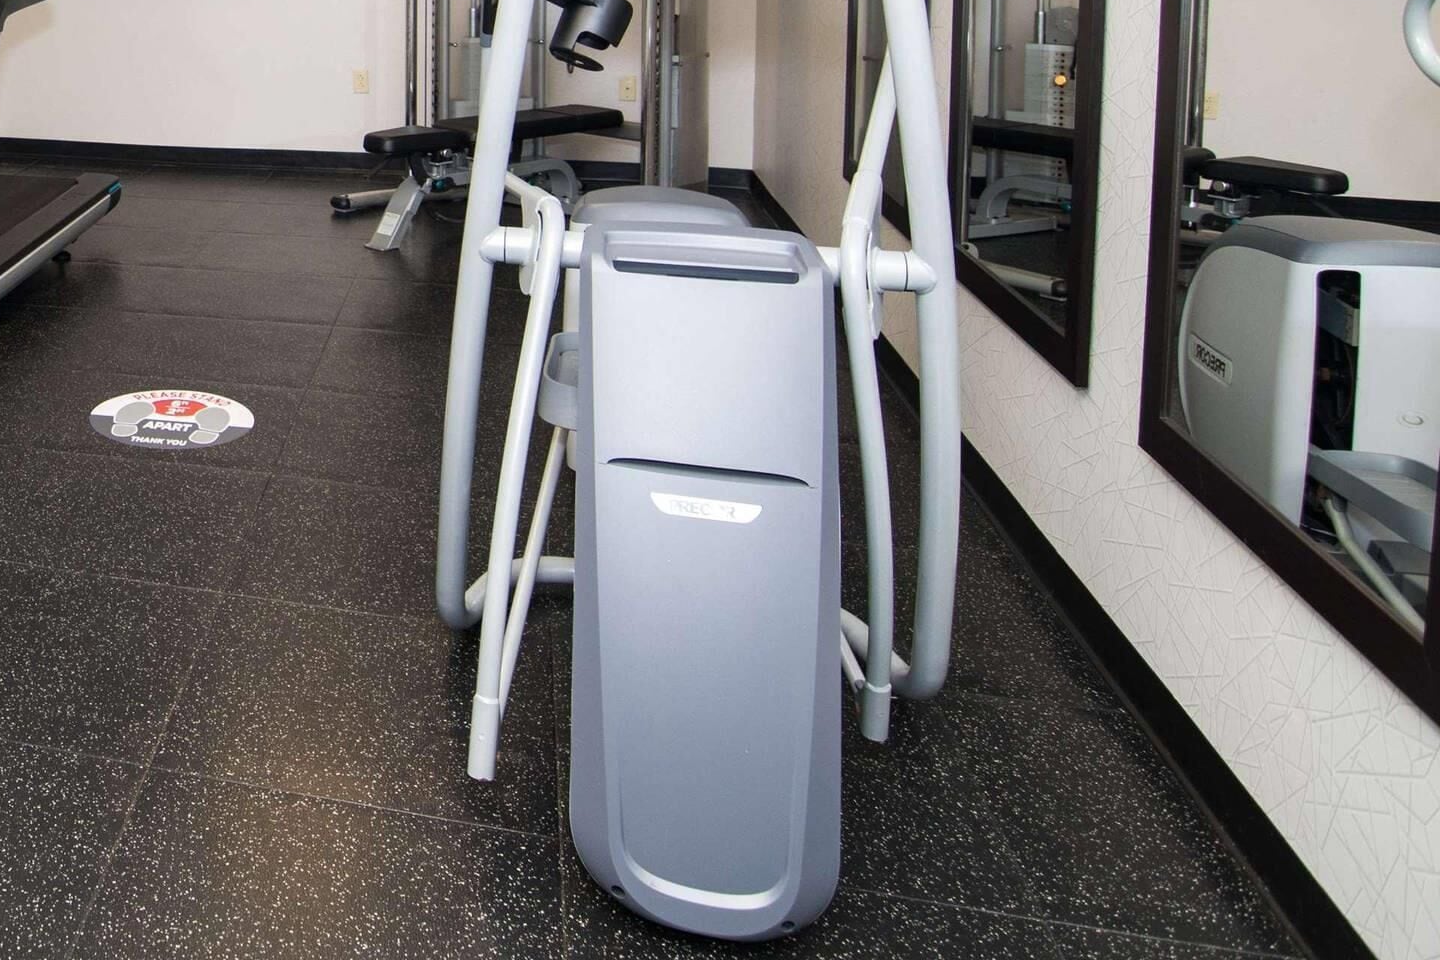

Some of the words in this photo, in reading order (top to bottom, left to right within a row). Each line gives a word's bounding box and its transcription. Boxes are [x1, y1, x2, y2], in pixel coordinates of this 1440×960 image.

[133, 391, 187, 401] PLEASE
[142, 421, 193, 432] APART
[131, 436, 165, 445] THANK
[671, 500, 736, 521] PRECR
